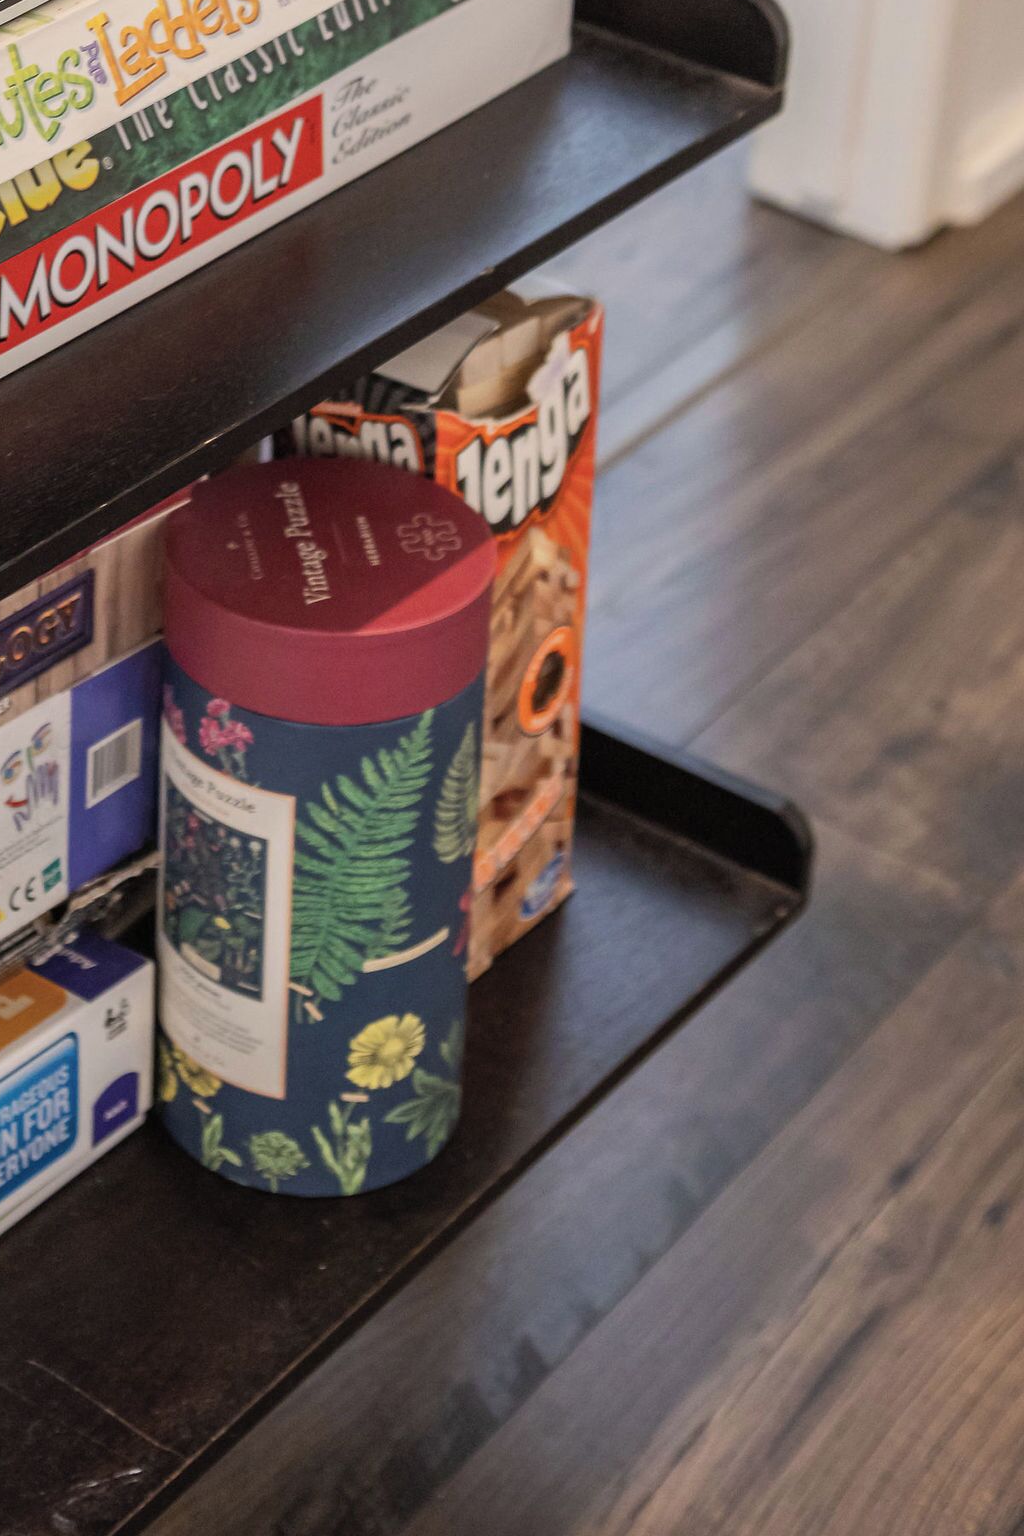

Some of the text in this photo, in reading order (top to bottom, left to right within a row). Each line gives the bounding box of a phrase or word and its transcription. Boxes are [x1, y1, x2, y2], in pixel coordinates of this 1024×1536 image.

[331, 76, 378, 113] The
[332, 85, 410, 139] Classic
[332, 110, 412, 164] Edition
[275, 480, 332, 606] Vintage Puzzle
[23, 1087, 72, 1142] FOR
